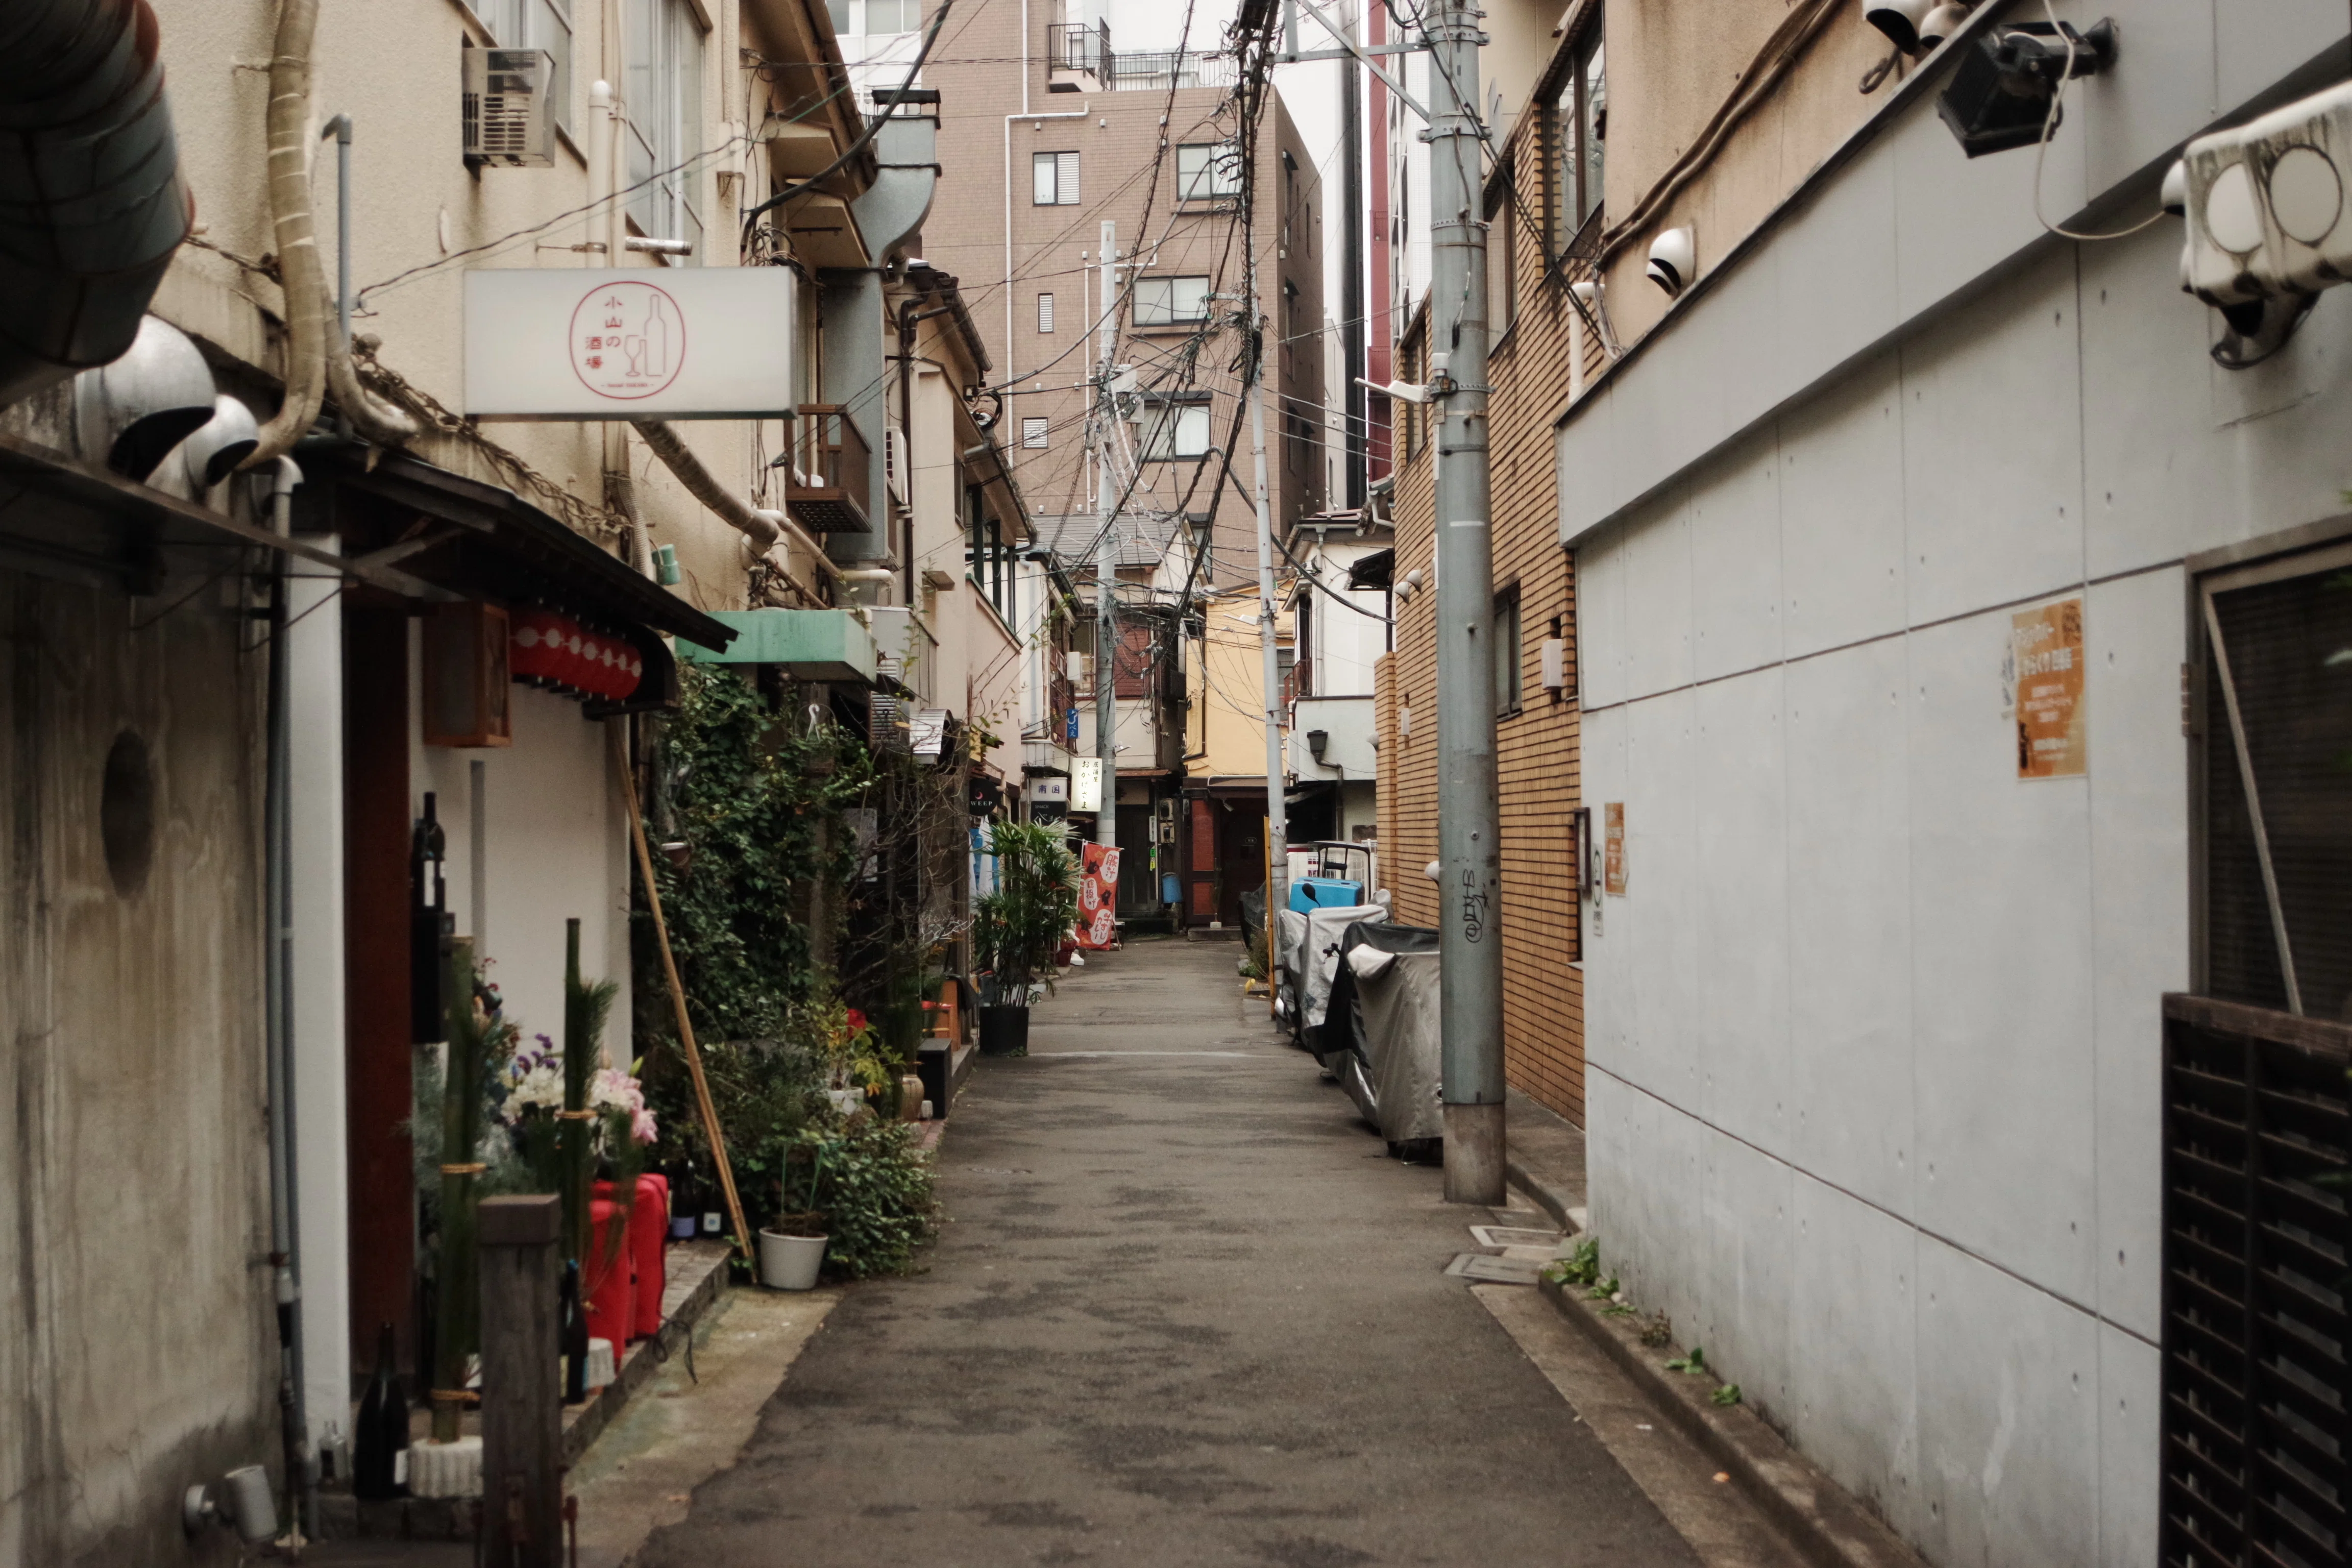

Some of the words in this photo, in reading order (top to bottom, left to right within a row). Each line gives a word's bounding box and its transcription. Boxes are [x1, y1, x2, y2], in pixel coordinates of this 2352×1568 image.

[604, 296, 623, 348] 小山の
[585, 336, 603, 369] 酒場
[1038, 785, 1060, 794] 南国
[1105, 853, 1118, 878] 豚汁
